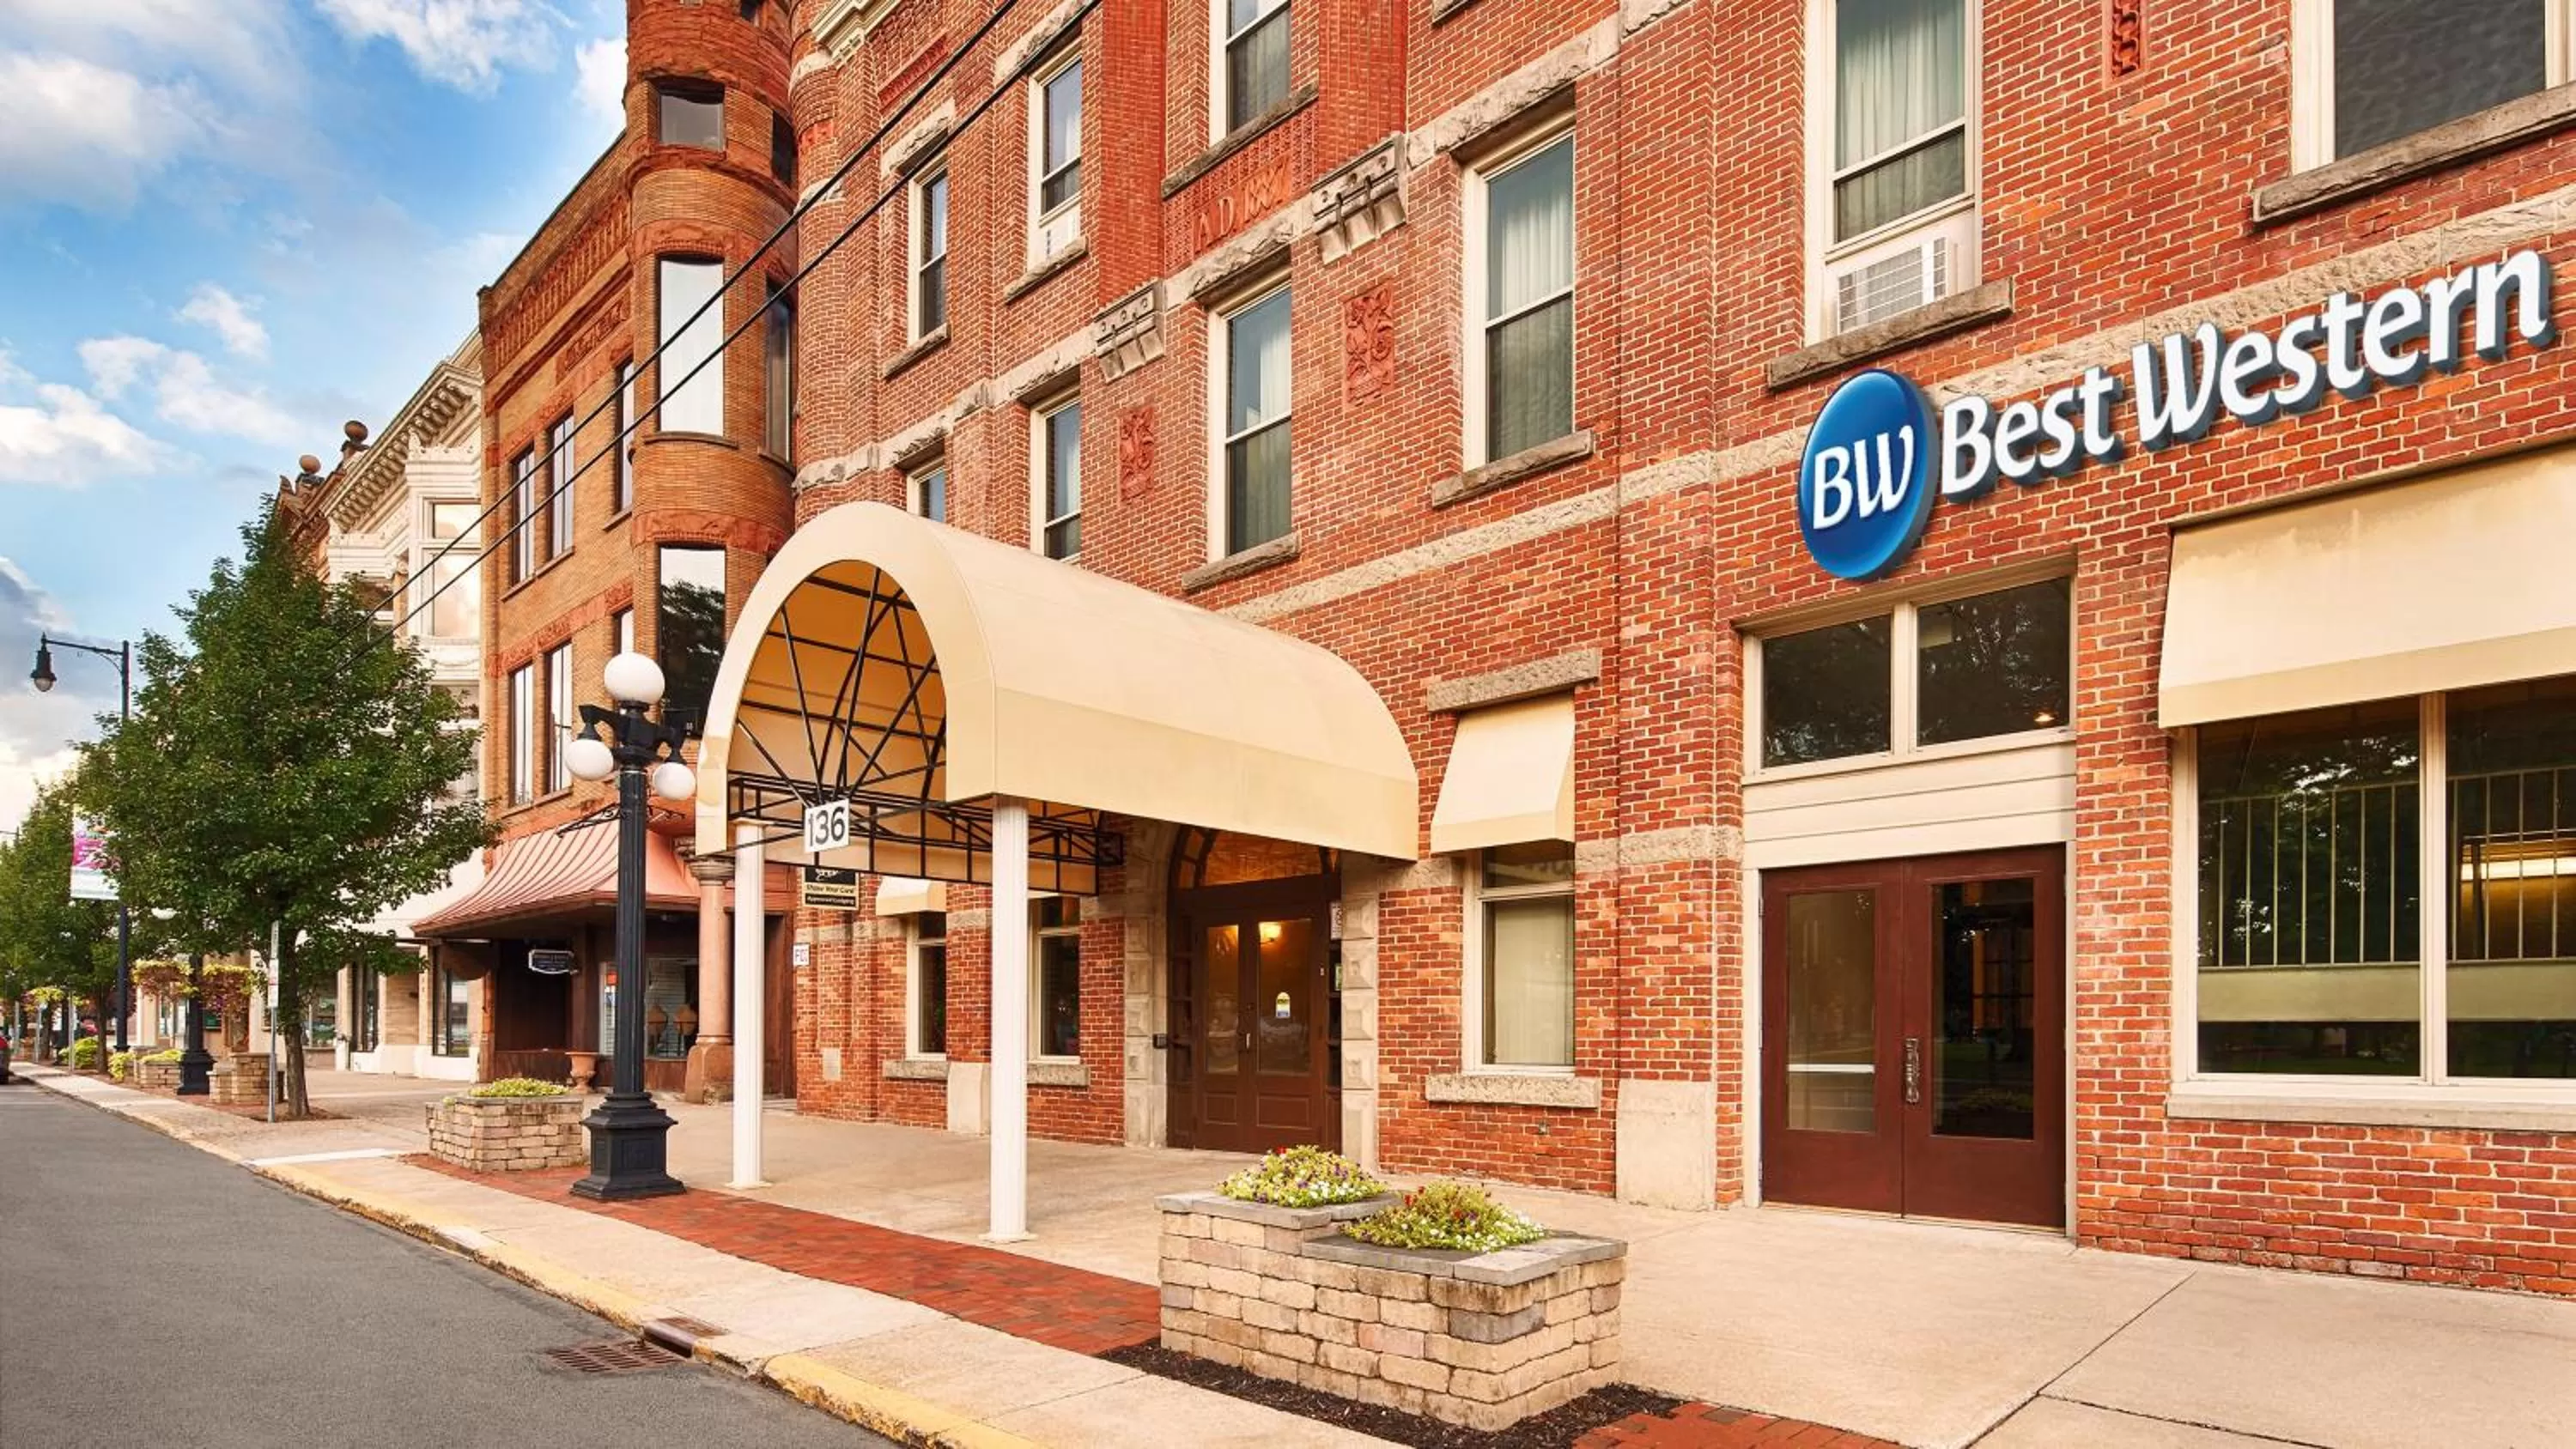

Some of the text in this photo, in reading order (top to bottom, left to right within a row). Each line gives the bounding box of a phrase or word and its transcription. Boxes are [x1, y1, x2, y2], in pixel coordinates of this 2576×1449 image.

[1941, 249, 2548, 494] Best Western
[1813, 425, 1914, 530] BW
[809, 806, 846, 847] 136
